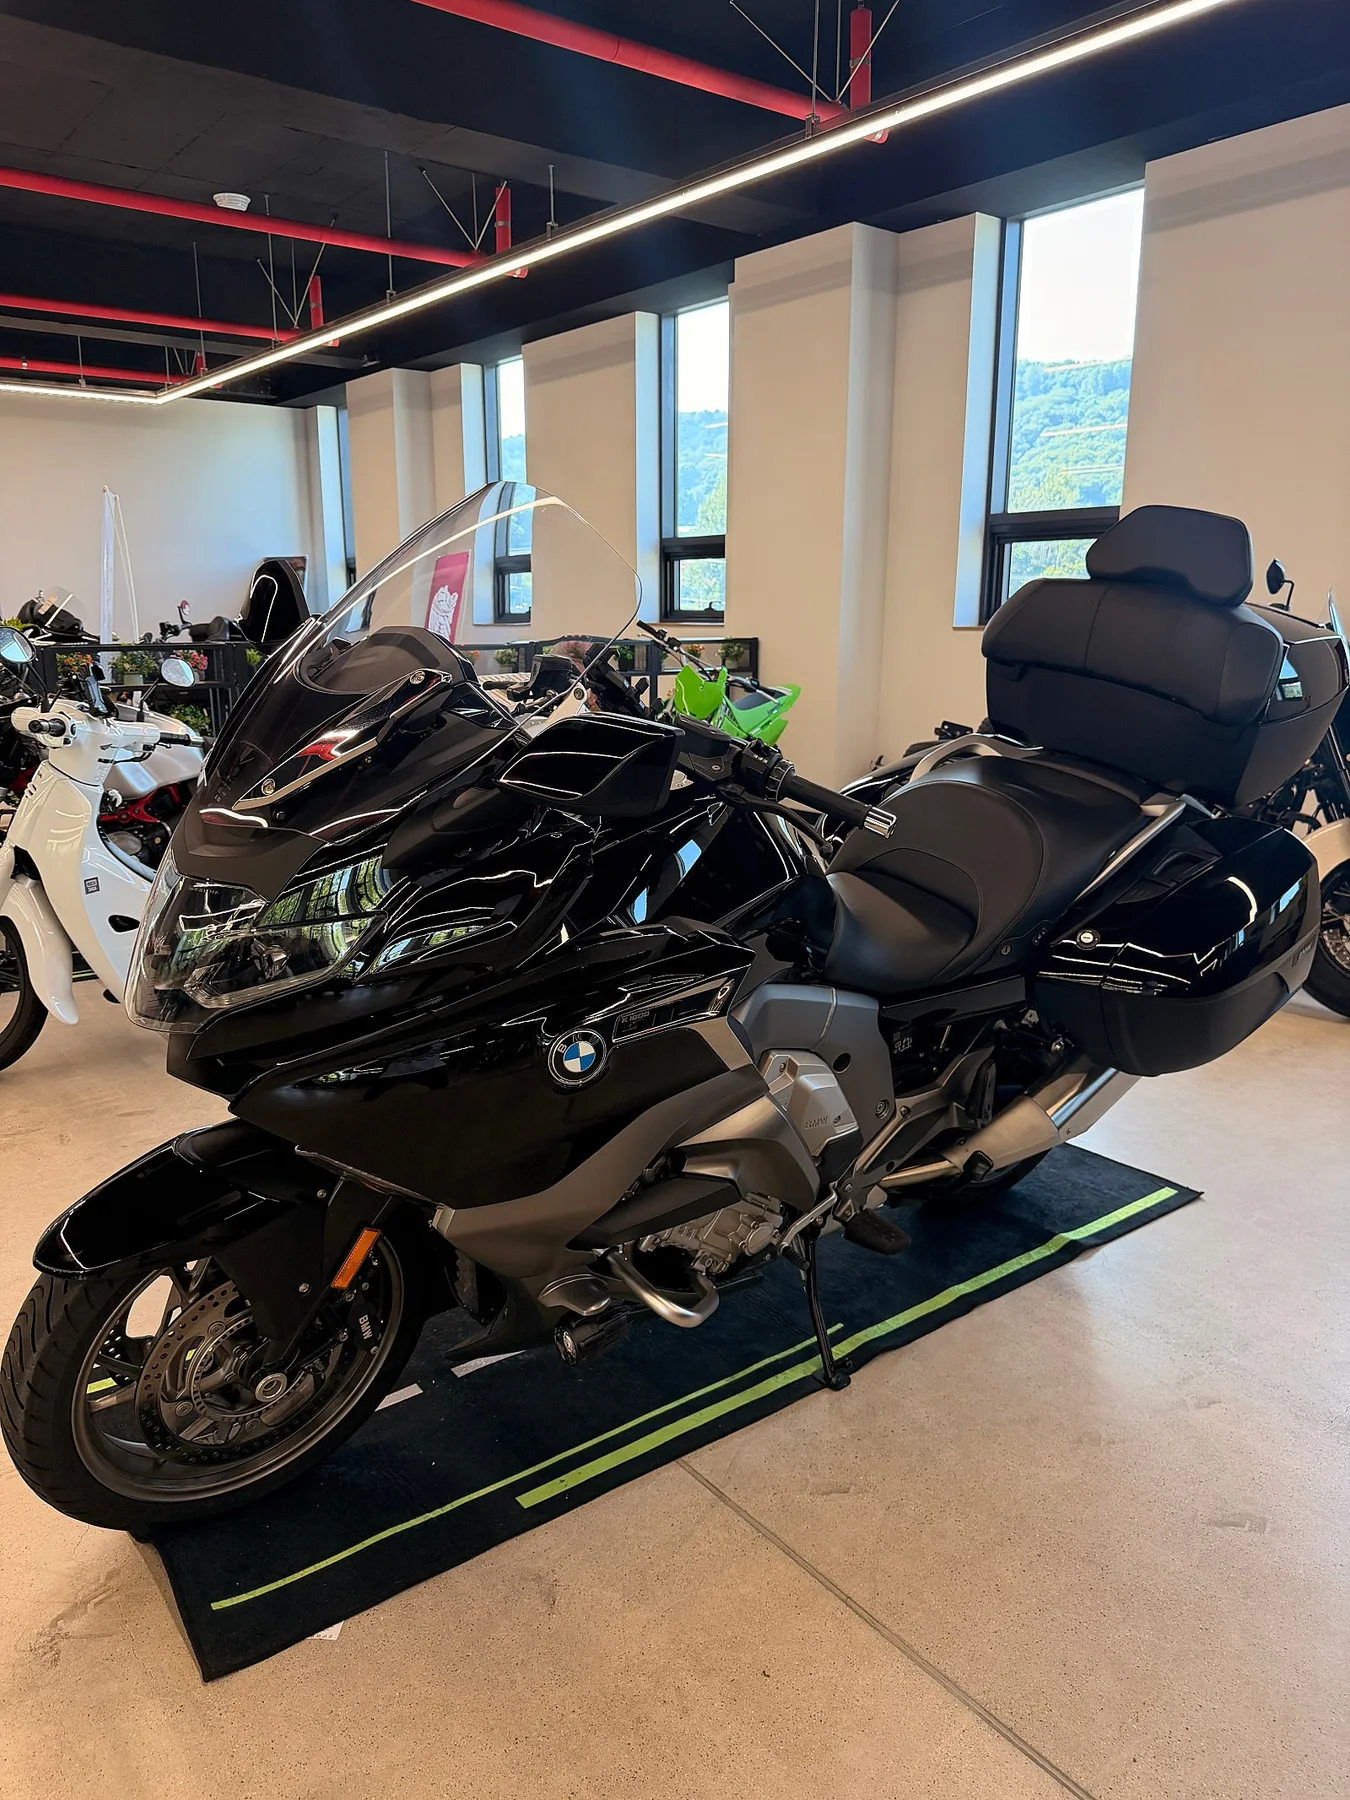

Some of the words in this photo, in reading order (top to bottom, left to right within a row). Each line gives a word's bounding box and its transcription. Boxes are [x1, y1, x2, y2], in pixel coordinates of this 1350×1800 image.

[557, 1033, 599, 1054] BMW
[805, 1115, 829, 1128] BMW
[358, 1314, 373, 1340] BMW
